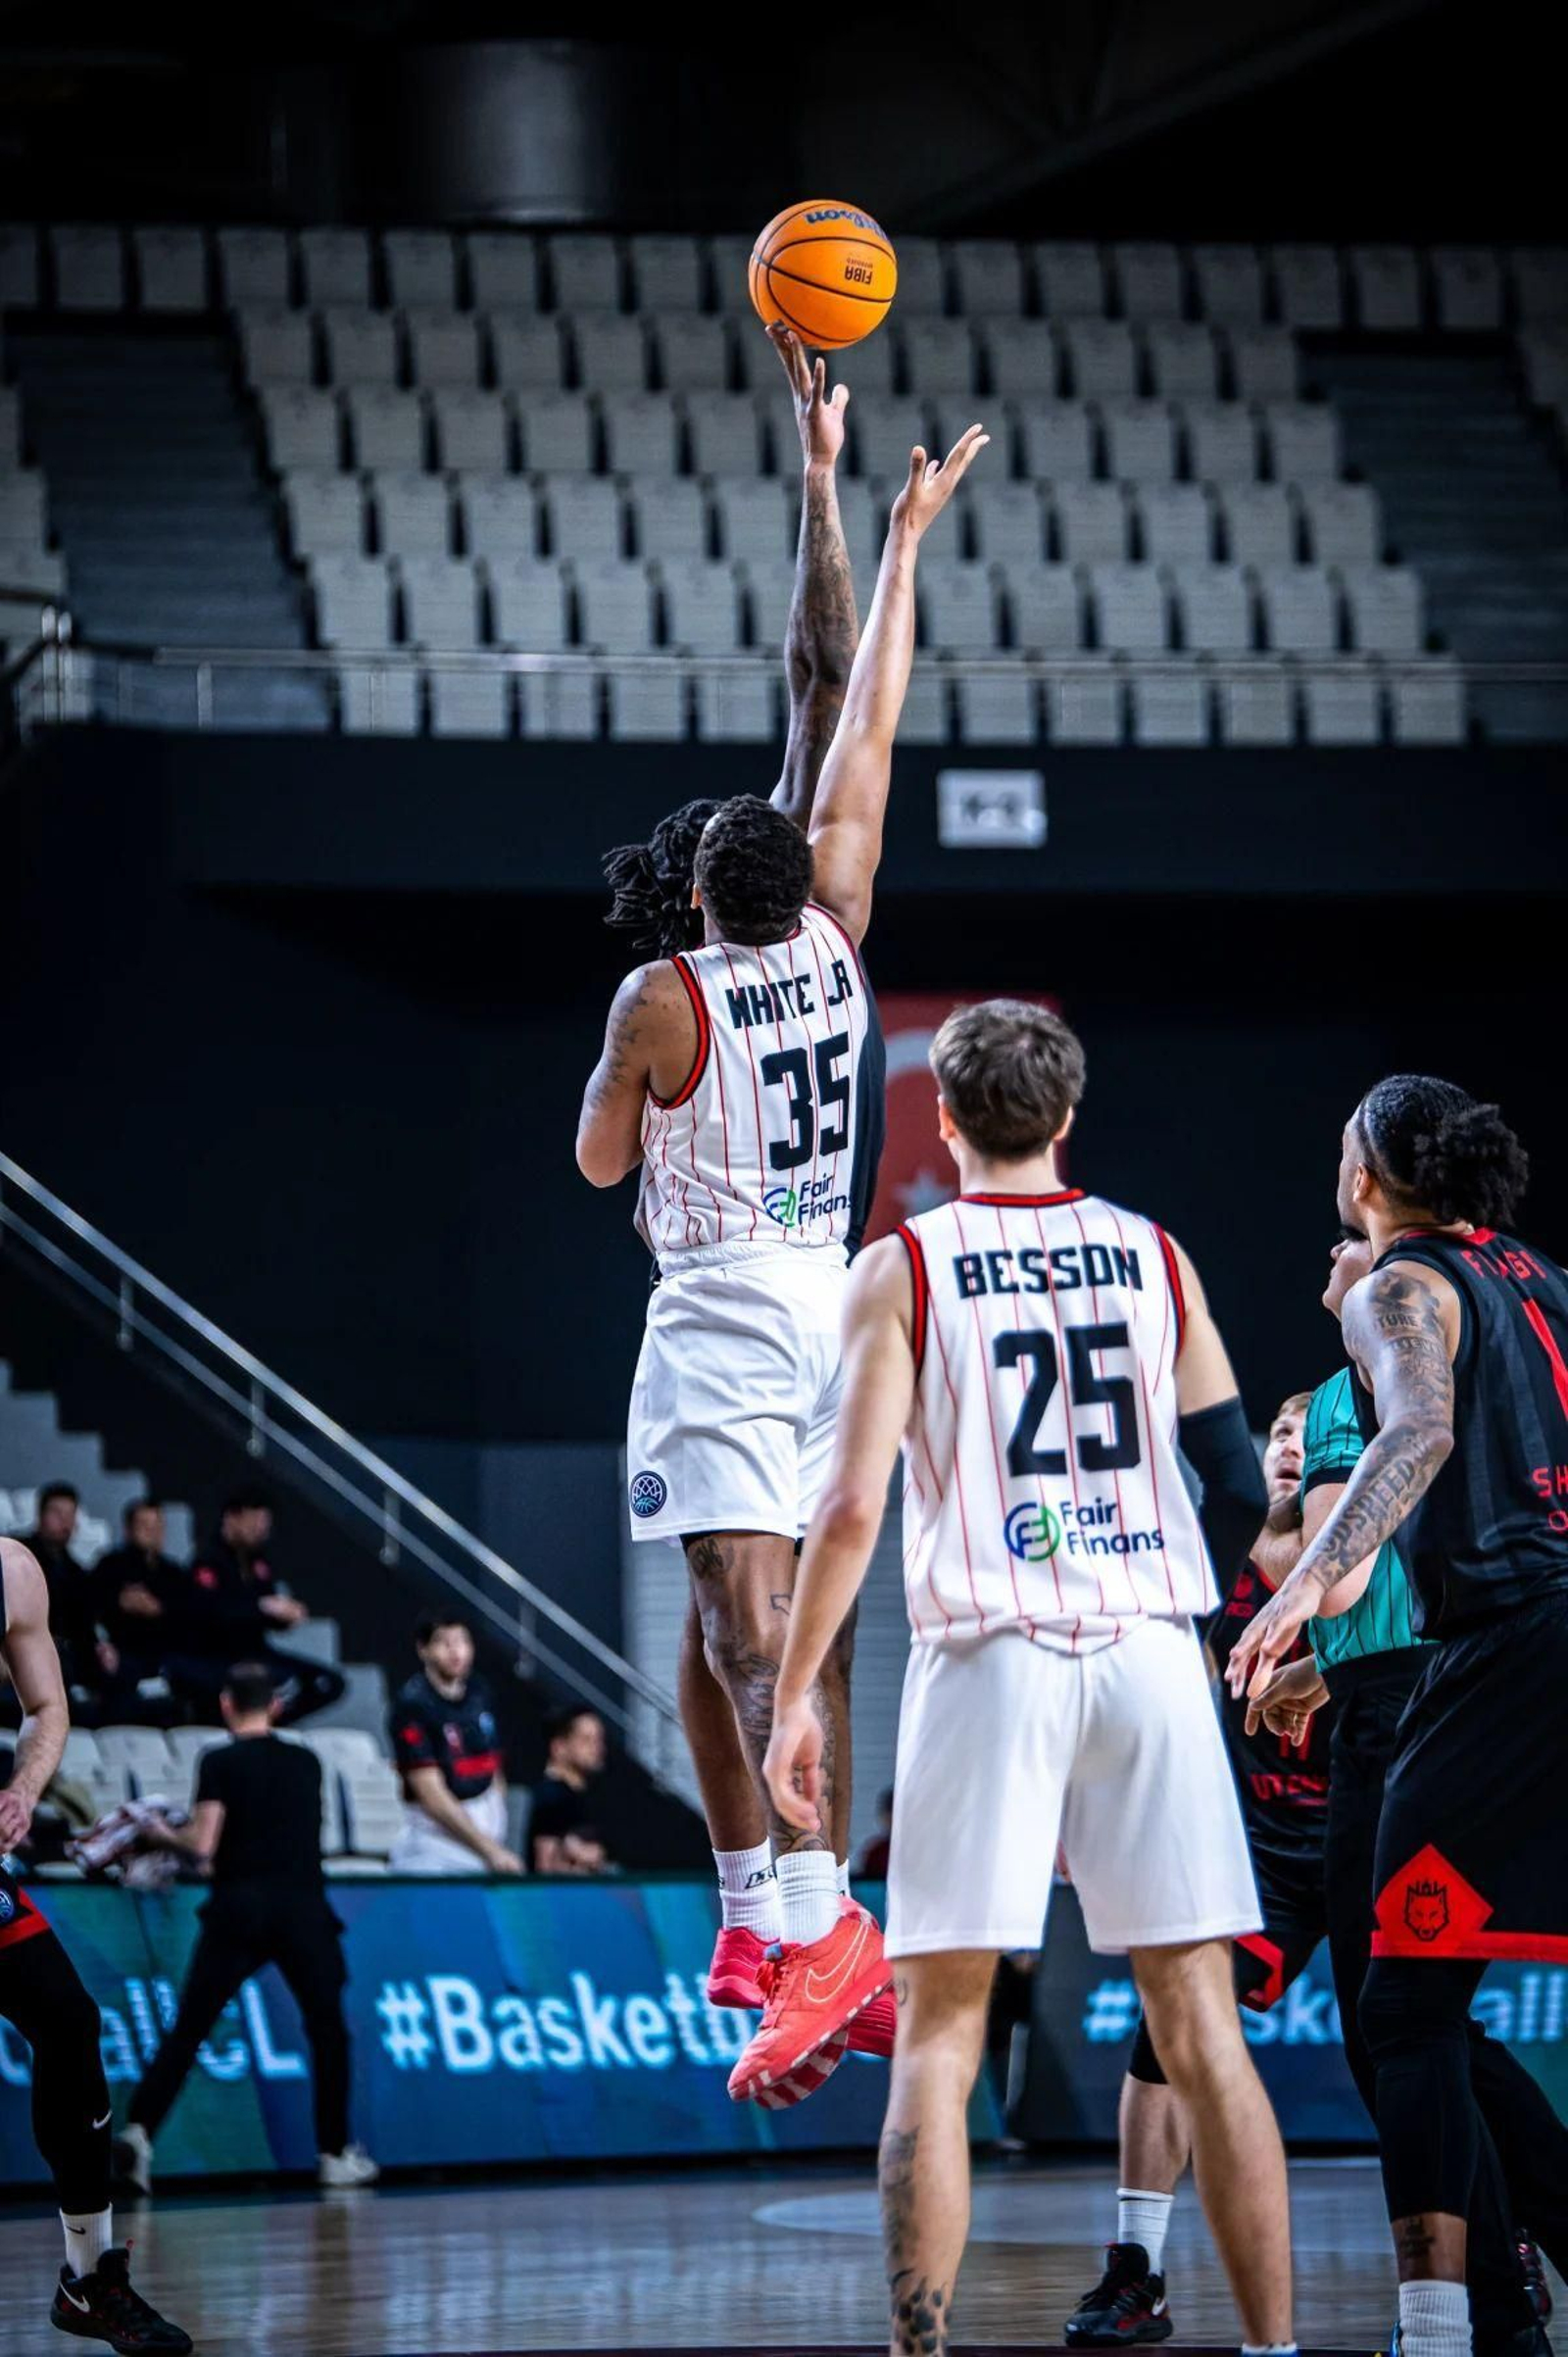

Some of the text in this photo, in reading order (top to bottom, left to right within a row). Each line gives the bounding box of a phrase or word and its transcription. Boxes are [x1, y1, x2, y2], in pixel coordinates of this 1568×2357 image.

[844, 265, 873, 285] FIBA
[724, 972, 815, 1029] WHITE
[760, 1031, 851, 1171] 35
[799, 1172, 835, 1202] Fair
[952, 1244, 1144, 1300] BESSON
[993, 1322, 1142, 1478] 25
[1059, 1497, 1117, 1526] Fair
[1066, 1528, 1165, 1556] Finans
